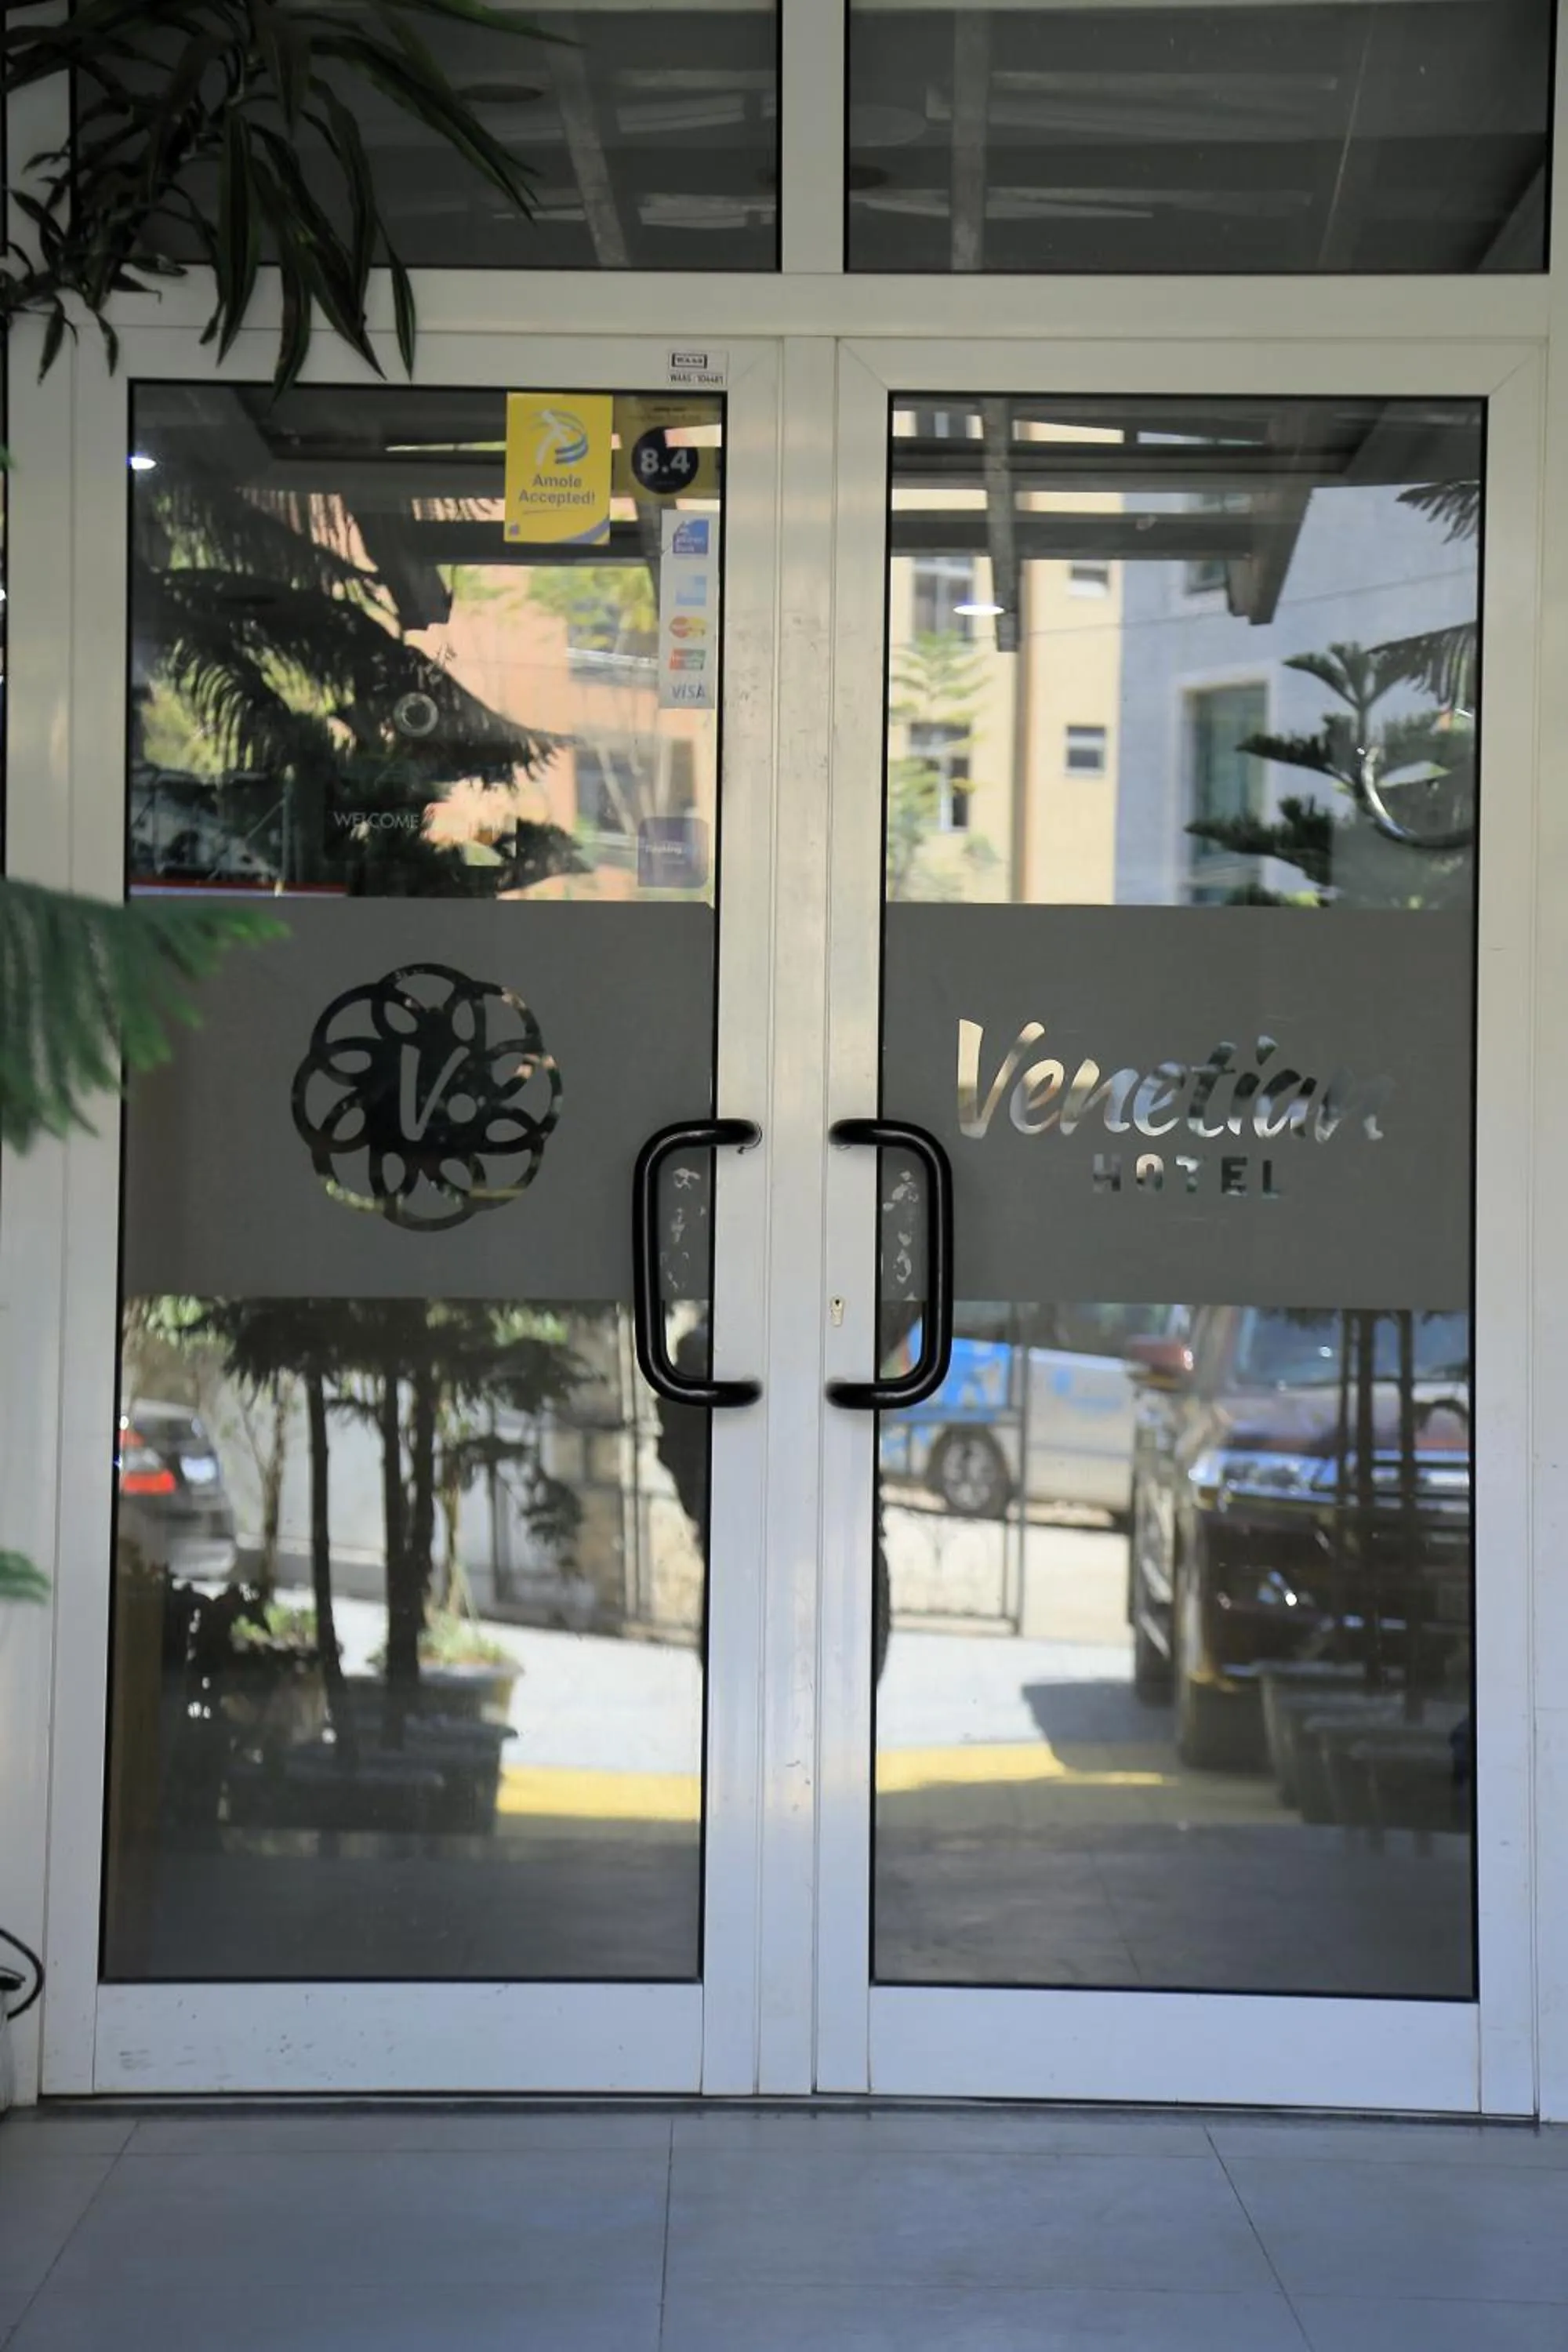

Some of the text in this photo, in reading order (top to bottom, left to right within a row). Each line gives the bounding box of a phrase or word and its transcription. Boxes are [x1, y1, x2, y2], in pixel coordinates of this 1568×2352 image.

[641, 448, 690, 474] 8.4
[532, 474, 583, 488] Amole
[518, 489, 595, 507] Accepted!
[672, 684, 706, 699] VISA
[334, 812, 419, 829] WELCOME
[957, 1019, 1396, 1145] Venetian
[1093, 1153, 1283, 1200] HOTEL
